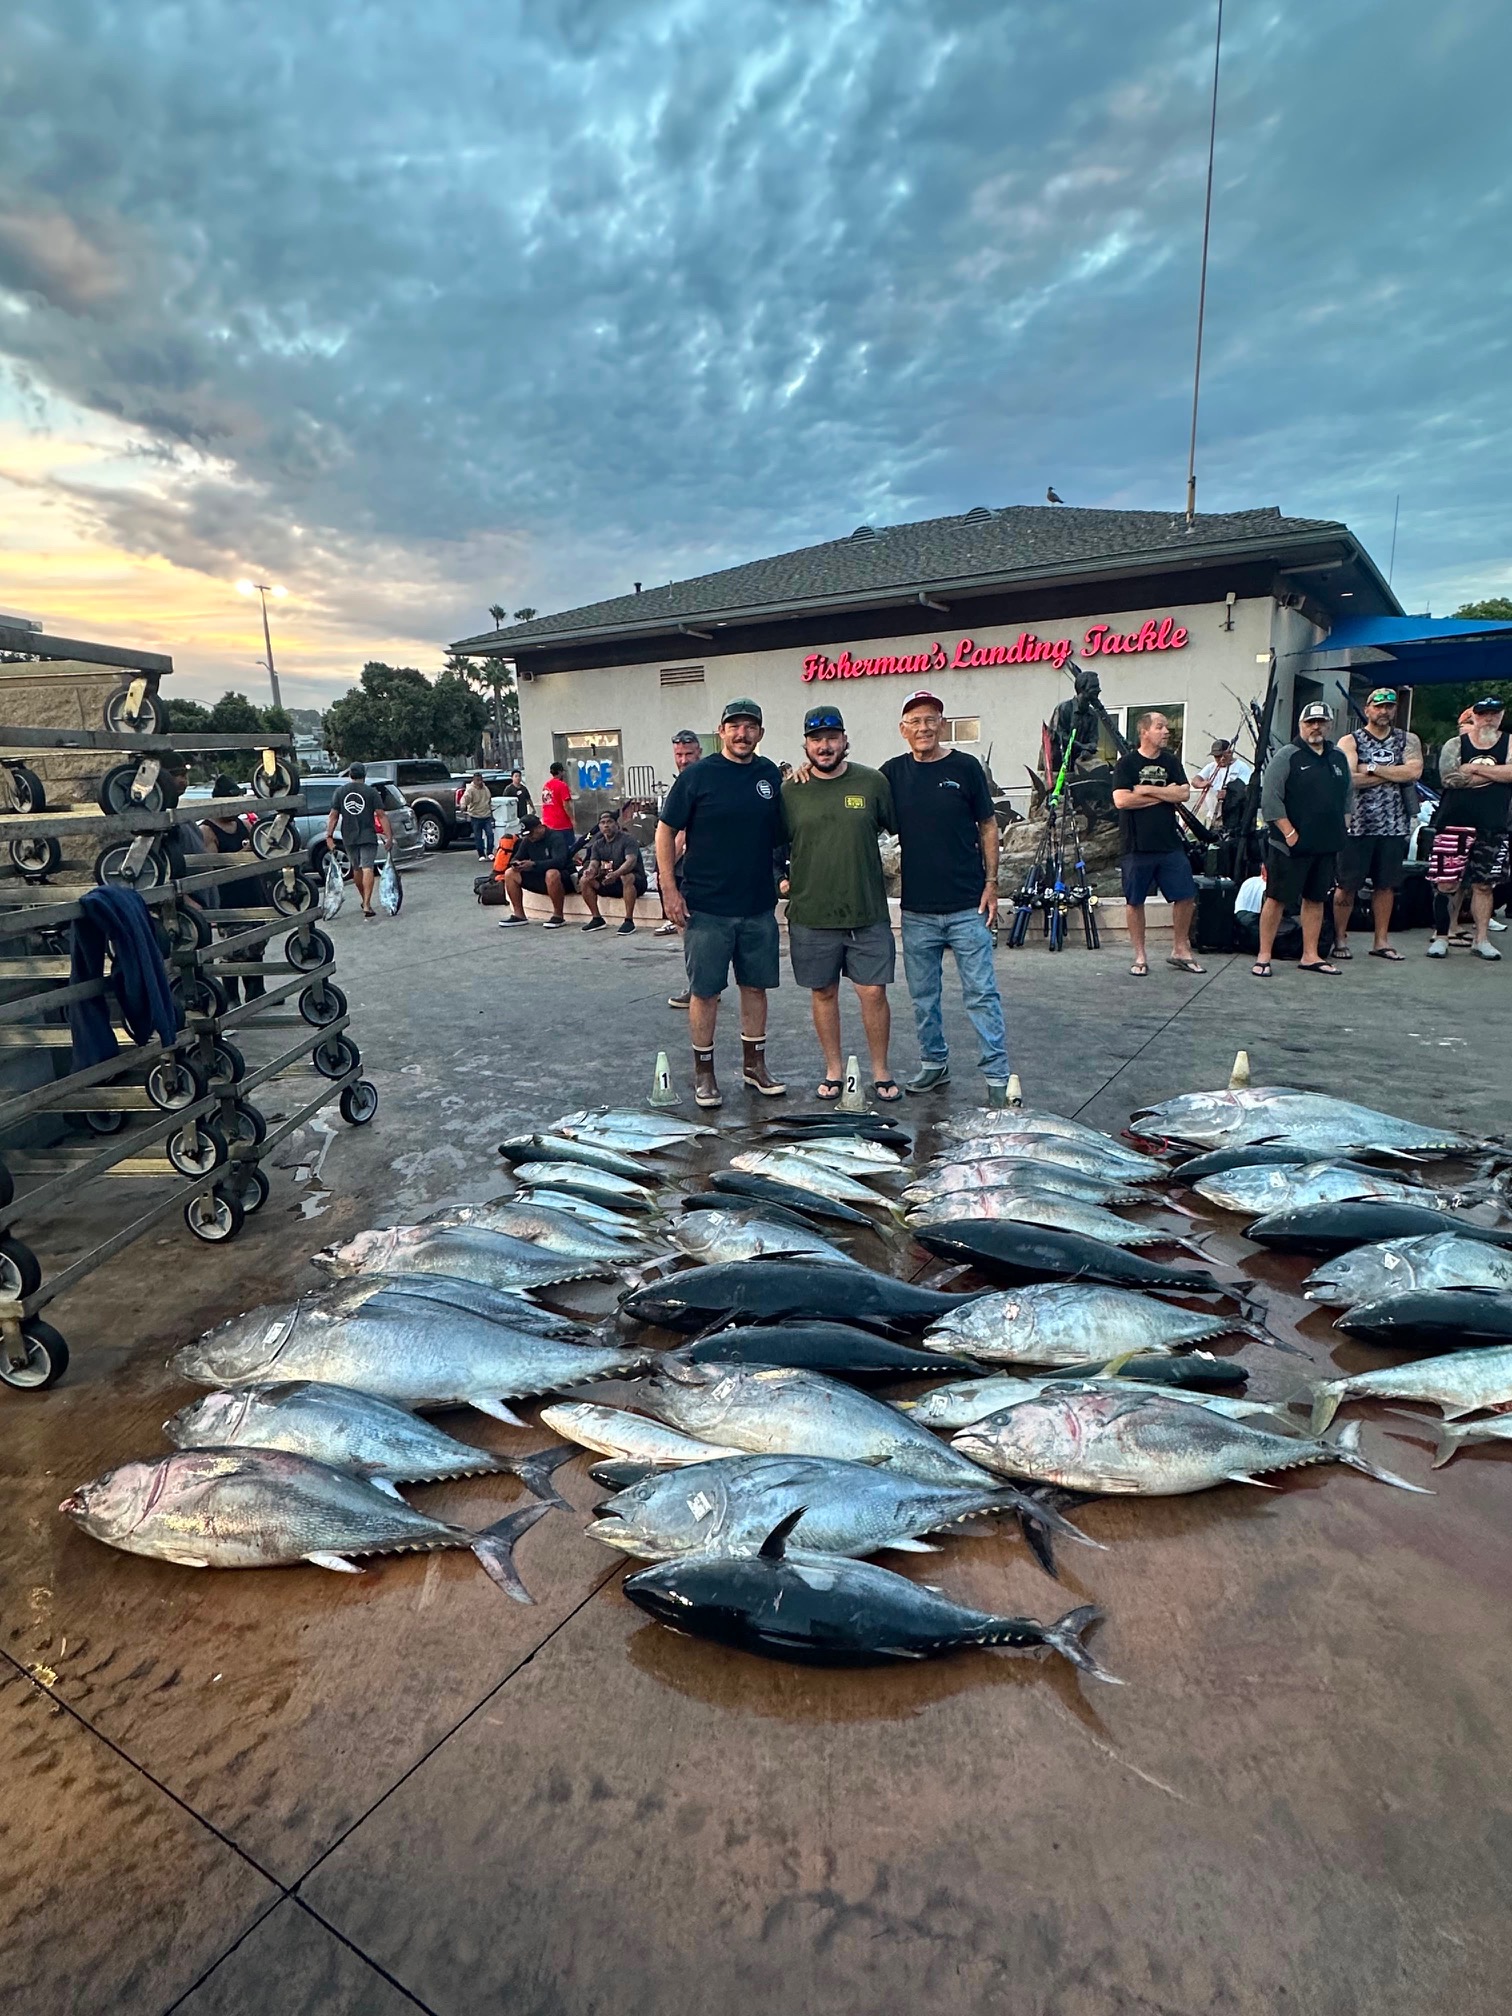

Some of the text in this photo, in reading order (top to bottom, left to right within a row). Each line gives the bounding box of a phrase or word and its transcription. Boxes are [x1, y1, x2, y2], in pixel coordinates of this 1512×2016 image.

[801, 617, 1188, 683] Fisherman's Landing Tackle
[661, 1072, 668, 1089] 1
[847, 1076, 856, 1093] 2
